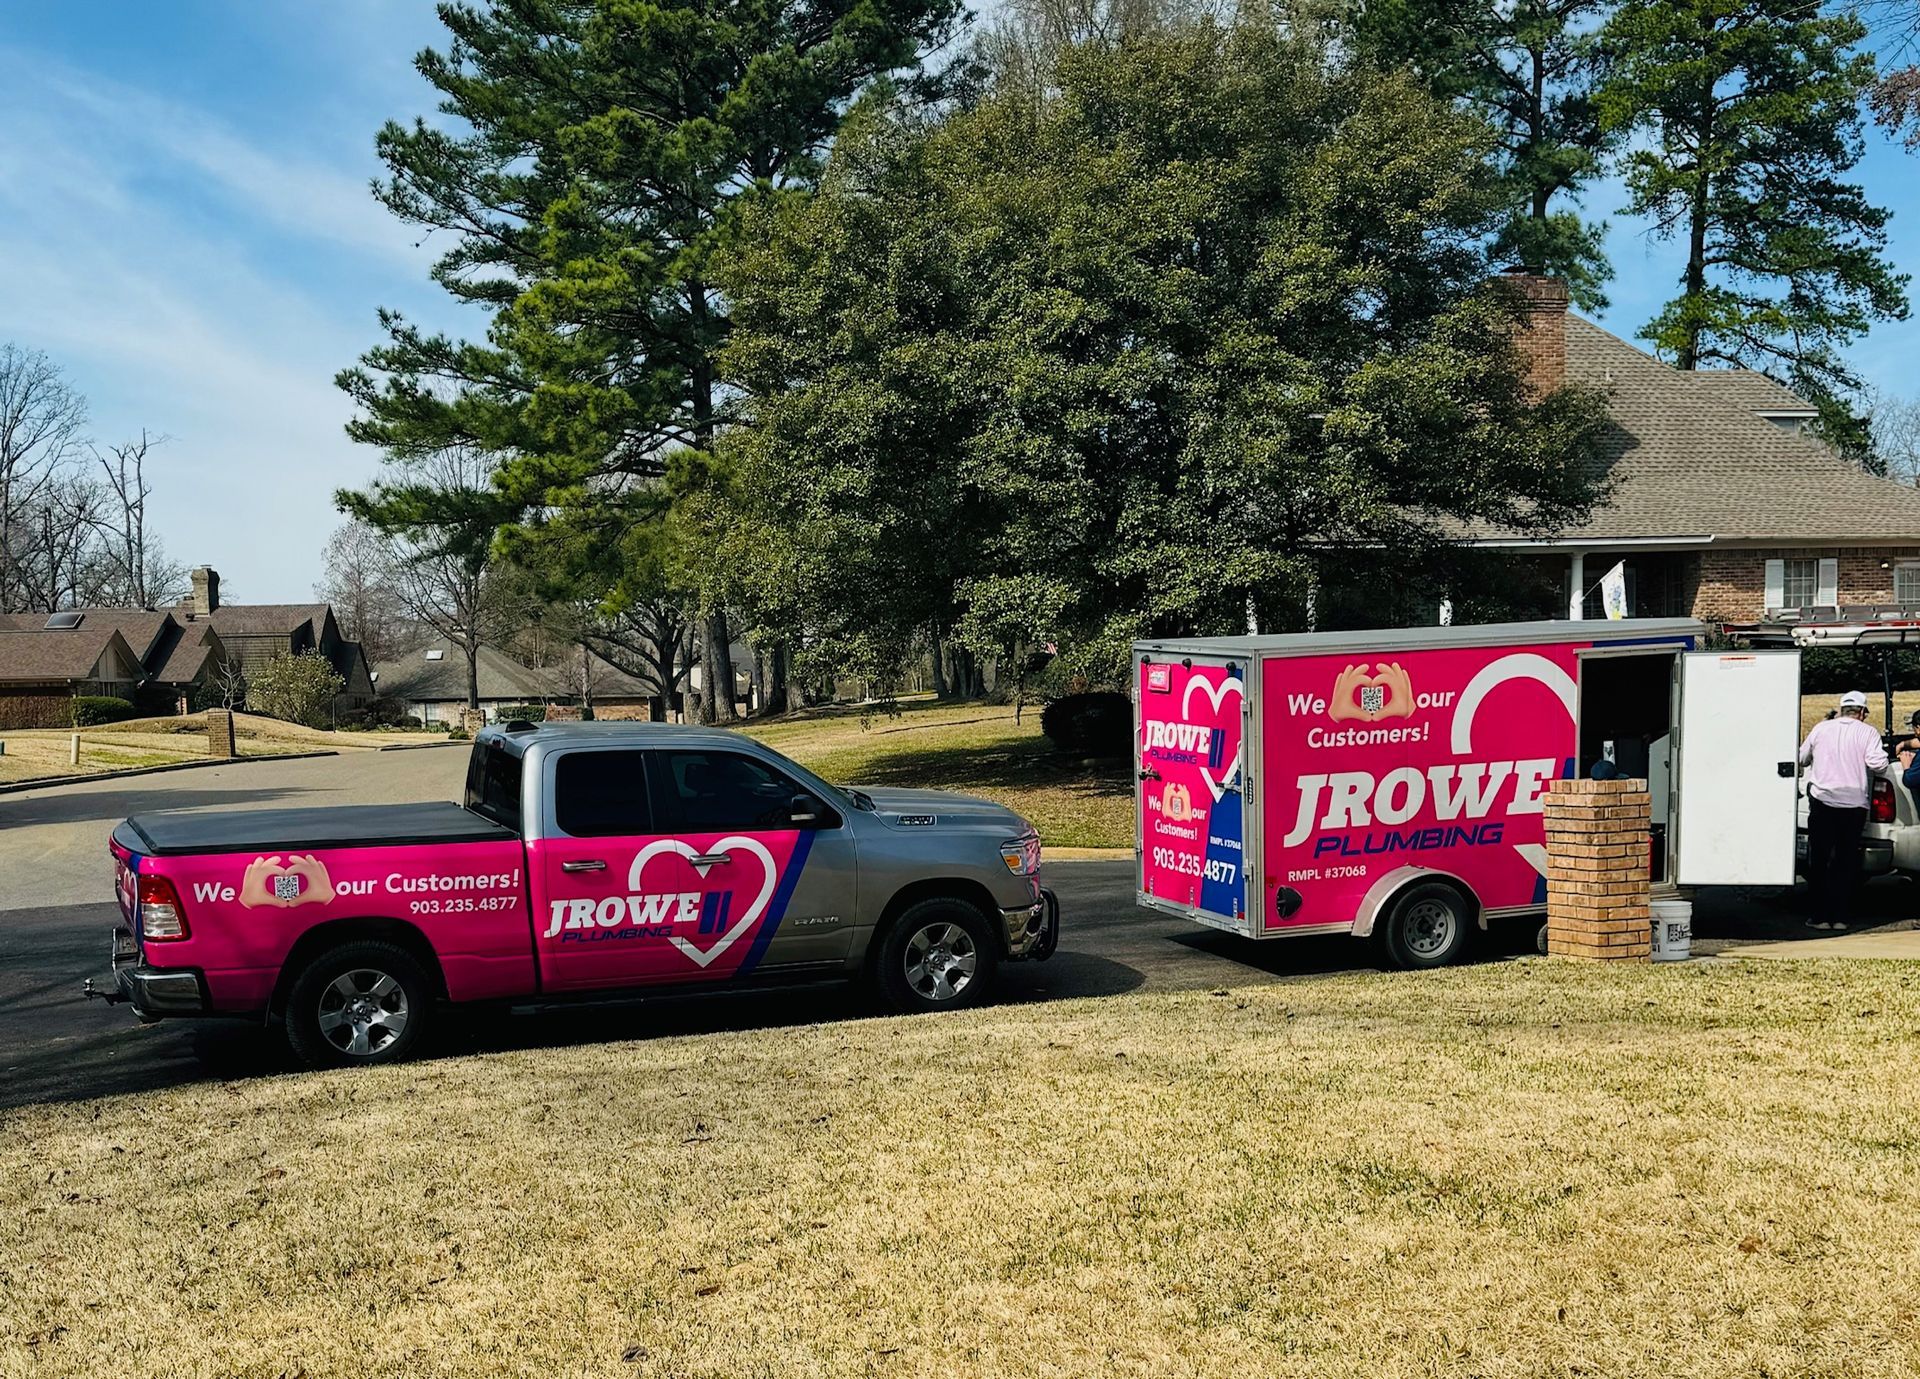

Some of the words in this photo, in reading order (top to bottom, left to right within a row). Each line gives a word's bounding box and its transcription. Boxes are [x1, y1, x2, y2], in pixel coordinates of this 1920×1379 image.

[1287, 693, 1326, 717] We
[1416, 690, 1455, 709] our
[1143, 719, 1211, 754] JROWE
[1307, 722, 1430, 748] Customers!
[1151, 749, 1197, 765] PLUMBING
[1148, 795, 1161, 811] We
[1191, 808, 1207, 820] our
[1283, 757, 1557, 848] JROWE
[1155, 819, 1198, 840] Customers!
[1313, 823, 1505, 859] PLUMBING
[1153, 846, 1236, 885] 903.235.4877
[1288, 867, 1321, 882] RMPL
[1324, 864, 1367, 879] #37068
[193, 882, 235, 903] We
[335, 878, 378, 896] our
[384, 868, 520, 894] Customers!
[410, 896, 518, 915] 903.235.4877
[543, 892, 702, 939] JROWE
[561, 925, 674, 944] PLUMBING
